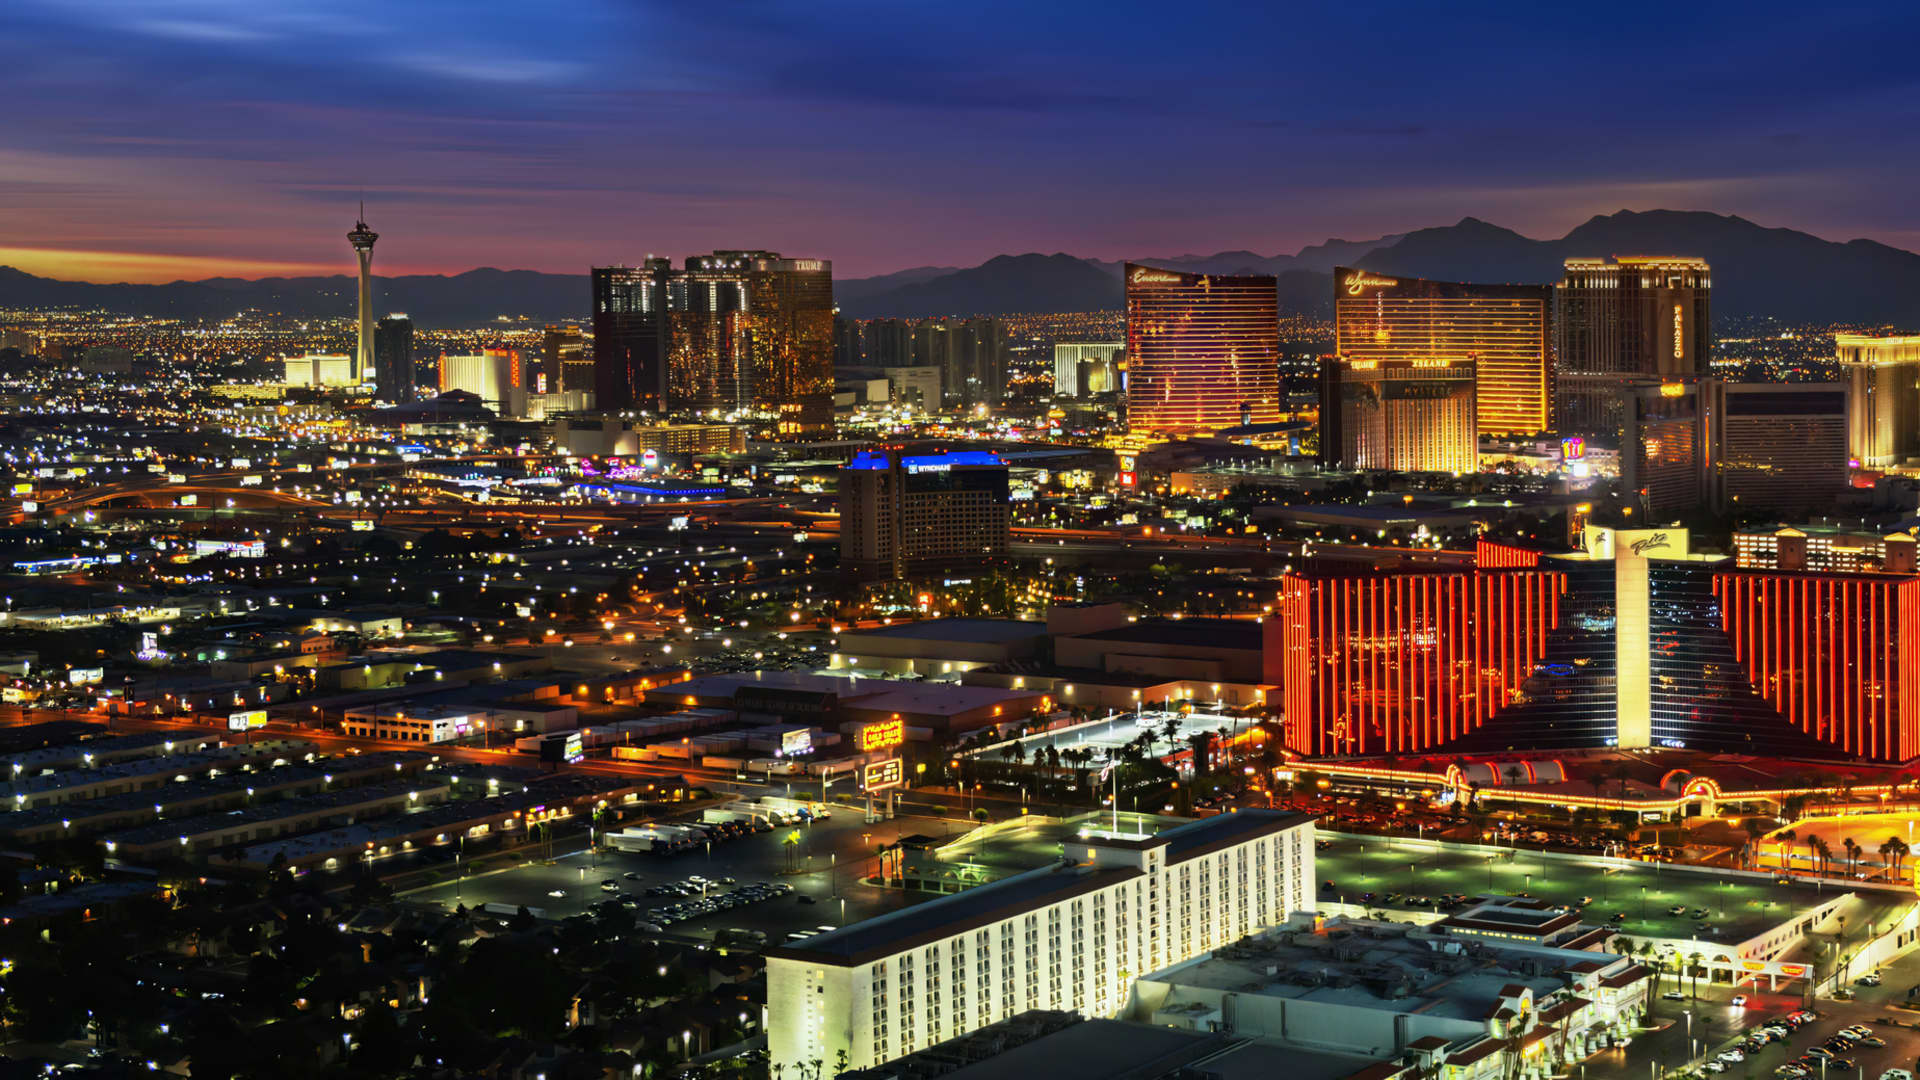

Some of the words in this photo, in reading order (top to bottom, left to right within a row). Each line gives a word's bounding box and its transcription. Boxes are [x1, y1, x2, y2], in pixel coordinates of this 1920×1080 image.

[795, 260, 823, 271] TRUMP
[1133, 268, 1181, 283] Encore
[1672, 305, 1683, 359] PALAZZO
[917, 463, 951, 473] WYNDHAM
[1630, 532, 1671, 556] Rio
